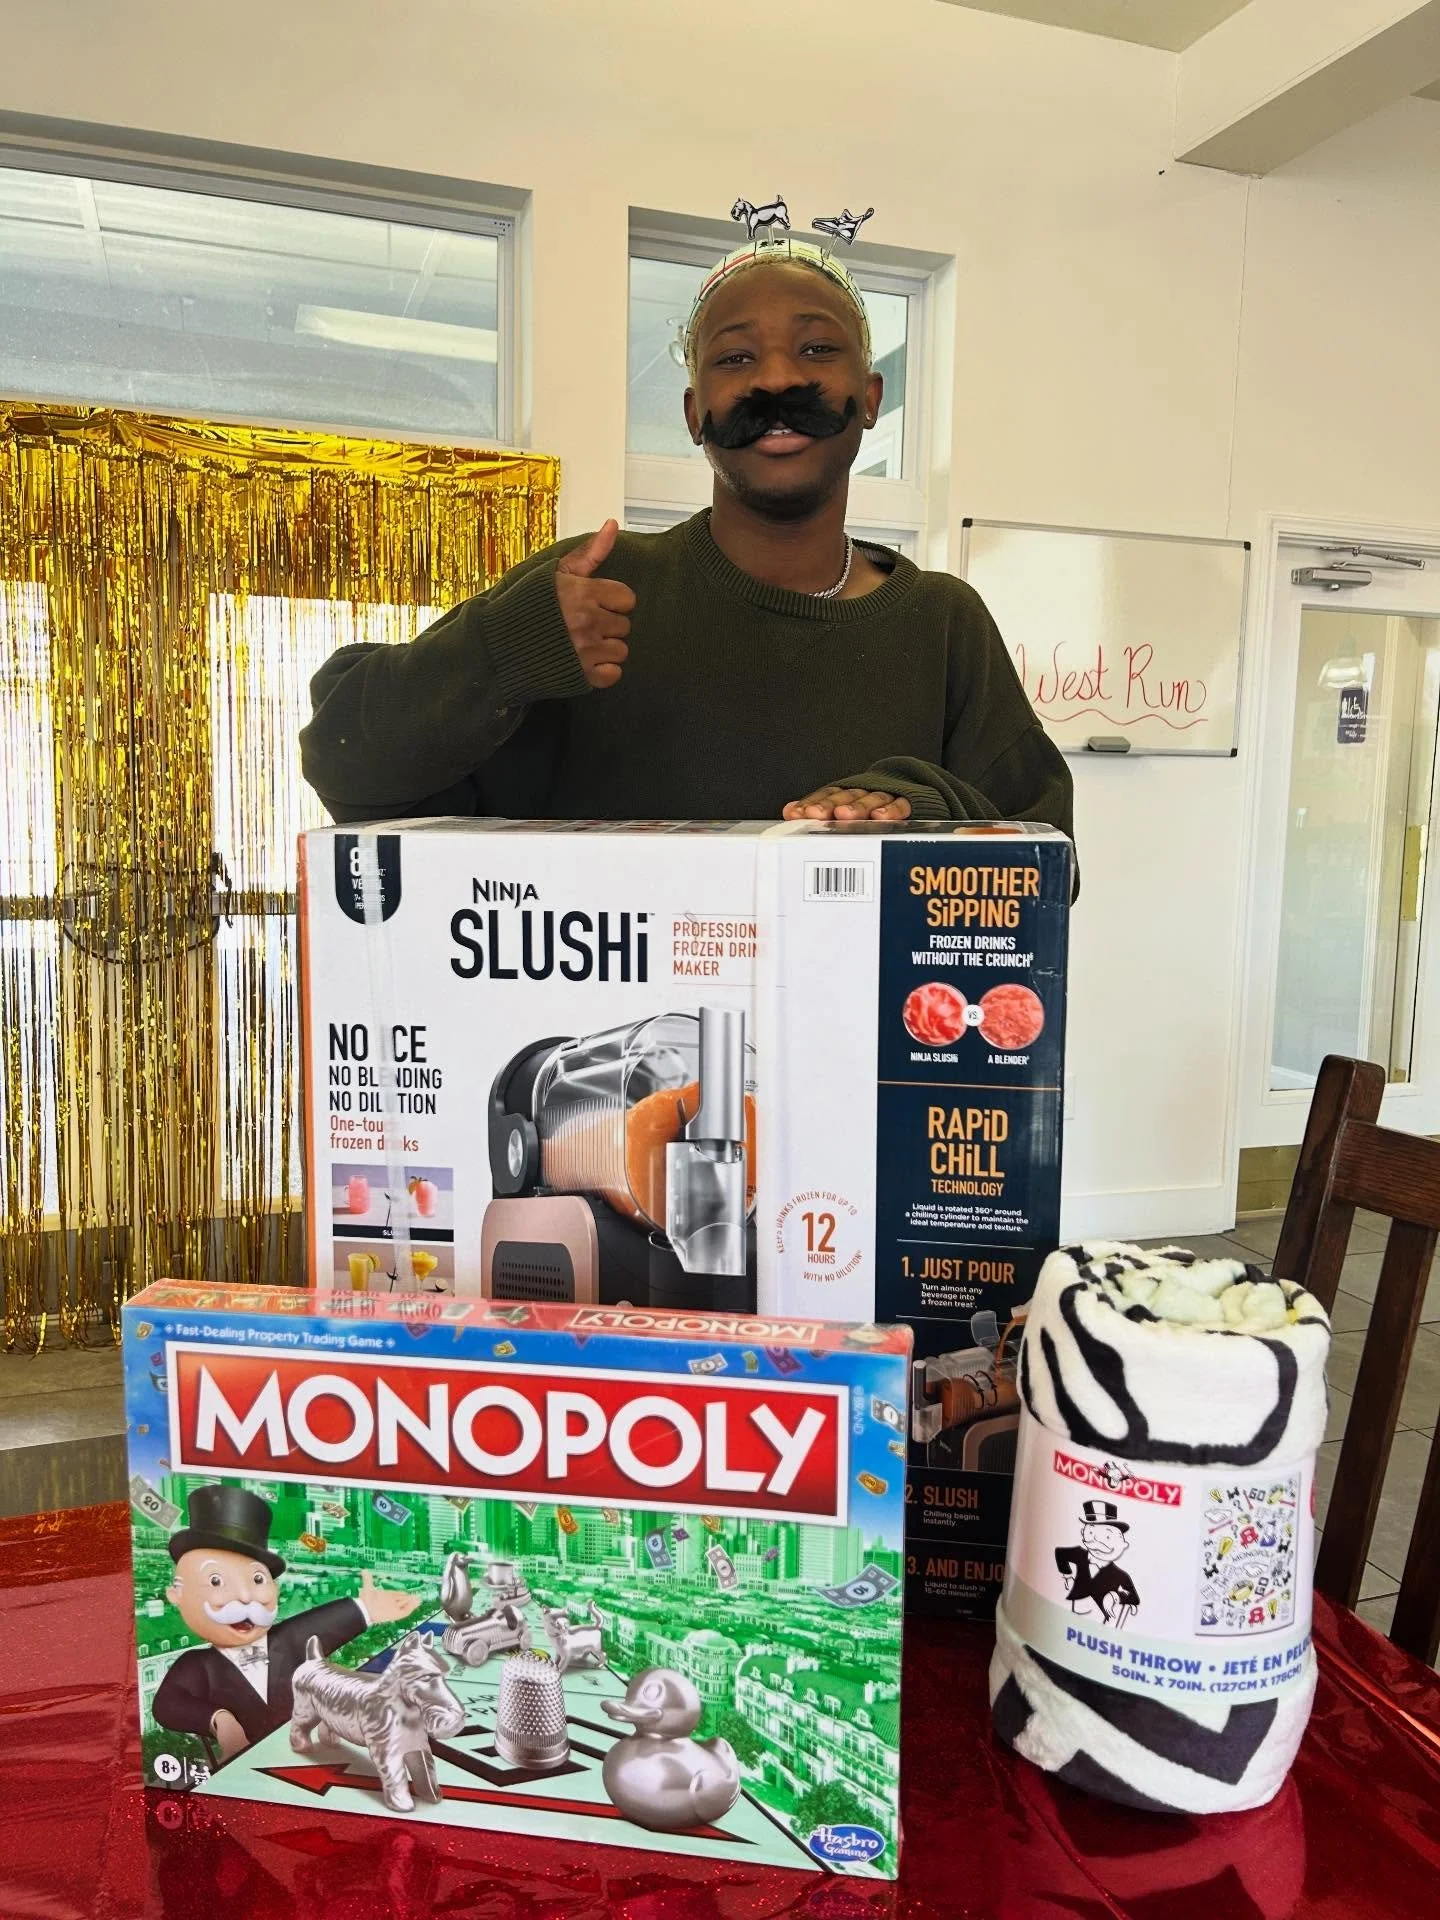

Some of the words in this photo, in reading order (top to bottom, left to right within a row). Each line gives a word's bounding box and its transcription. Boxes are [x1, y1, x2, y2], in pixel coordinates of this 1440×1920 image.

[1016, 641, 1113, 704] West
[1123, 643, 1207, 713] Run
[909, 866, 1040, 897] SMOOTHER
[472, 877, 540, 909] NINJA
[673, 921, 757, 939] PROFESSION
[673, 940, 723, 957] FROZEN
[929, 934, 972, 950] FROZEN
[974, 936, 1017, 951] DRINKS
[673, 959, 720, 976] MAKER
[911, 951, 961, 966] WITHOUT
[962, 952, 983, 967] THE
[329, 1022, 369, 1062] NO
[392, 1024, 427, 1063] CE
[910, 1051, 932, 1062] NINJA
[987, 1054, 994, 1064] A
[329, 1065, 351, 1086] NO
[358, 1066, 443, 1089] BLNDING
[329, 1091, 352, 1111] NO
[359, 1091, 437, 1115] DILTION
[330, 1115, 384, 1133] One-tou
[927, 1106, 1009, 1142] RAPiD
[330, 1133, 373, 1150] frozen
[377, 1134, 420, 1152] dks
[930, 1142, 1005, 1178] CHiLL
[822, 1191, 837, 1202] FOR
[931, 1178, 1004, 1197] TECHNOLOGY
[792, 1191, 820, 1206] FROZEN
[837, 1198, 849, 1207] UP
[776, 1203, 794, 1229] DRINKS
[848, 1205, 858, 1216] TO
[911, 1210, 939, 1220] chilling
[940, 1211, 970, 1221] cylinder
[981, 1215, 1014, 1224] maintain
[1016, 1216, 1029, 1225] the
[912, 1203, 936, 1213] Liquid
[945, 1205, 973, 1213] rotated
[994, 1208, 1022, 1216] around
[801, 1211, 836, 1253] 12
[930, 1219, 976, 1230] temperature
[978, 1221, 992, 1230] and
[994, 1223, 1024, 1232] texture.
[776, 1231, 785, 1254] KEEPS
[807, 1253, 836, 1265] HOURS
[803, 1271, 822, 1283] WITH
[824, 1273, 835, 1282] NO
[901, 1256, 915, 1278] 1.
[919, 1257, 963, 1280] JUST
[968, 1260, 1015, 1284] POUR
[921, 1283, 939, 1291] Turn
[940, 1284, 967, 1293] almost
[968, 1286, 983, 1295] any
[921, 1290, 958, 1300] beverage
[959, 1293, 975, 1301] into
[927, 1298, 953, 1307] frozen
[580, 1312, 807, 1340] MONOPOLY
[175, 1325, 246, 1341] Fast-Dealing
[248, 1328, 300, 1345] Property
[302, 1331, 346, 1348] Trading
[348, 1333, 383, 1348] Game
[196, 1363, 826, 1496] MONOPOLY
[1056, 1454, 1179, 1503] MONOPOLY
[144, 1495, 159, 1511] 20
[905, 1483, 918, 1504] 2.
[923, 1485, 979, 1509] SLUSH
[923, 1509, 952, 1520] Chilling
[954, 1512, 980, 1521] begins
[907, 1555, 920, 1576] 3.
[925, 1557, 959, 1578] AND
[964, 1560, 1005, 1582] ENJO
[924, 1581, 948, 1590] Liquid
[949, 1582, 958, 1590] to
[960, 1583, 978, 1592] slush
[1066, 1626, 1123, 1659] PLUSH
[1129, 1649, 1202, 1675] THROW
[1223, 1655, 1258, 1675] JETÉ
[1263, 1653, 1282, 1672] EN
[1112, 1664, 1150, 1684] 50IN.
[1155, 1676, 1165, 1687] X
[1168, 1678, 1206, 1692] 70IN.
[1210, 1679, 1257, 1693] (127CM
[1260, 1678, 1268, 1689] X
[161, 1760, 178, 1774] 8+
[812, 1827, 879, 1849] Hasbro
[823, 1841, 870, 1862] Gaming
